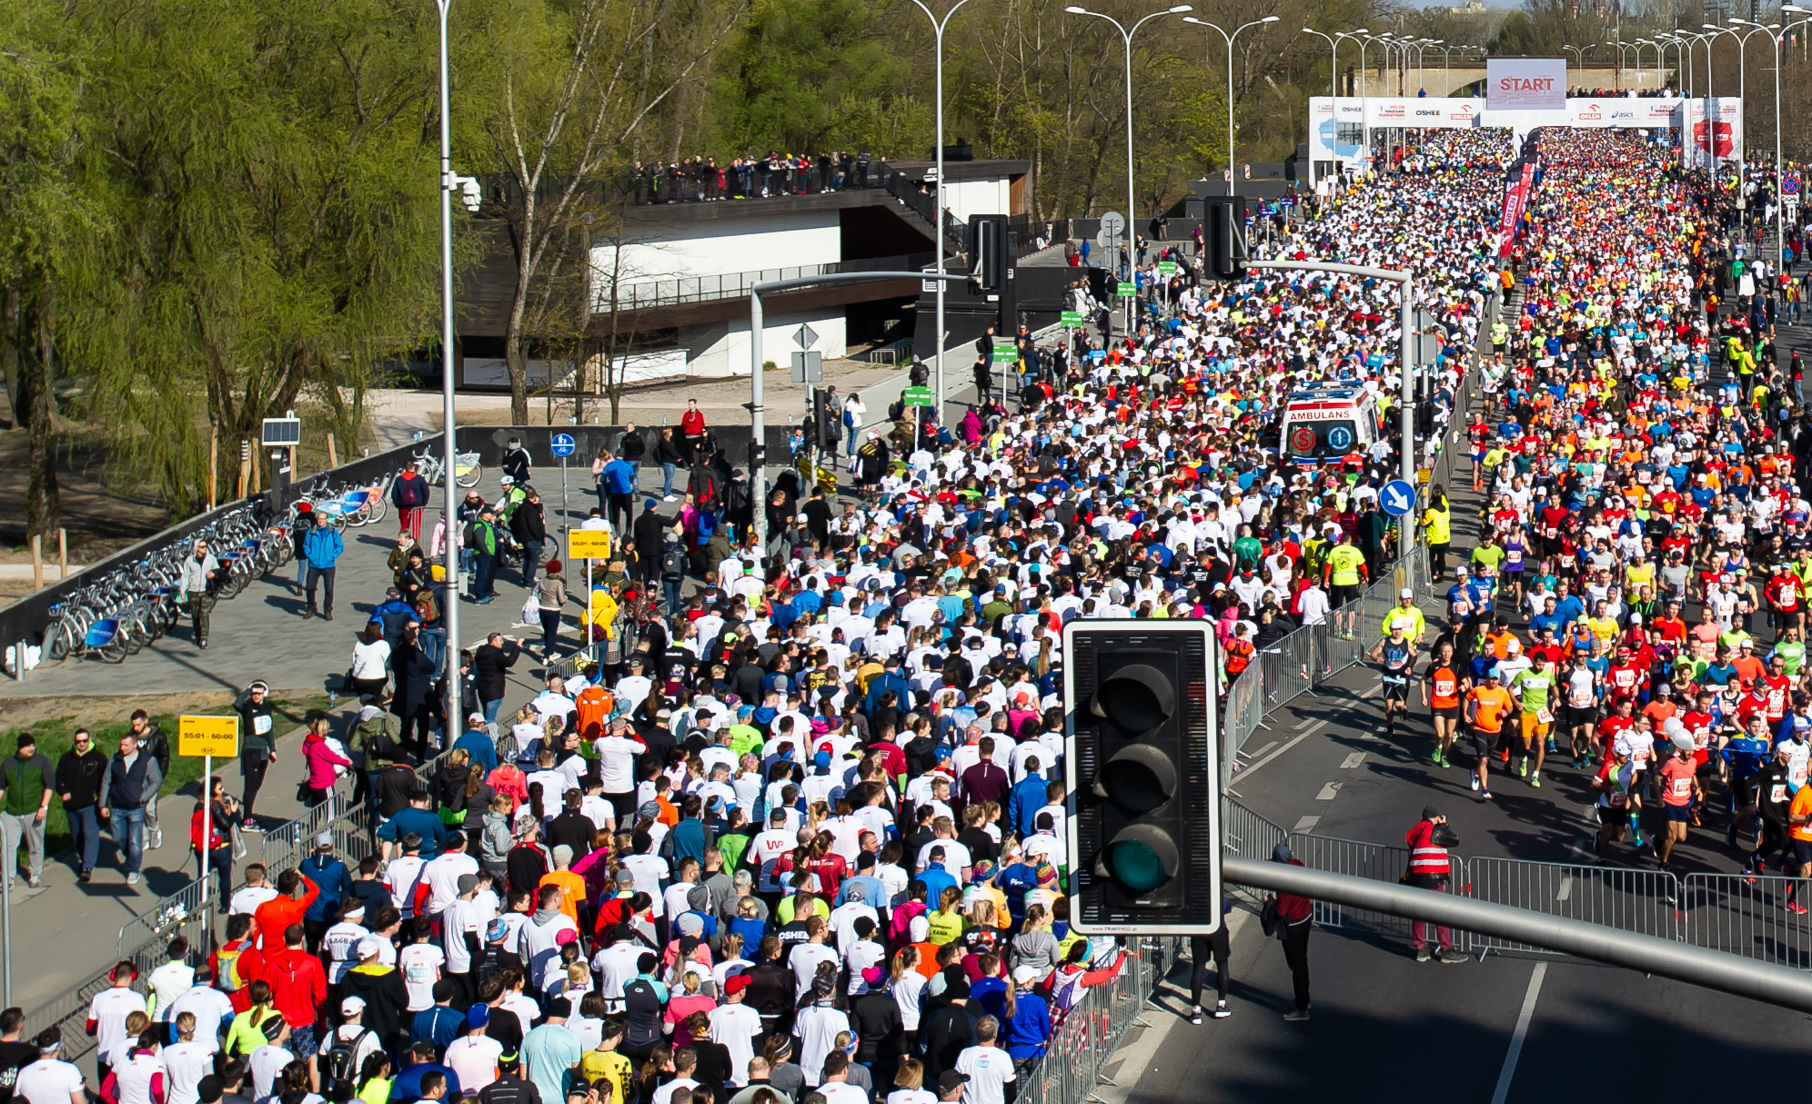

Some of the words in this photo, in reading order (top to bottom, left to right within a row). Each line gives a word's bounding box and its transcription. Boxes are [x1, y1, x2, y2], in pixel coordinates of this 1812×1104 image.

[1500, 77, 1555, 92] START
[1504, 197, 1517, 225] ORLEN
[1290, 410, 1350, 421] AMBULANS
